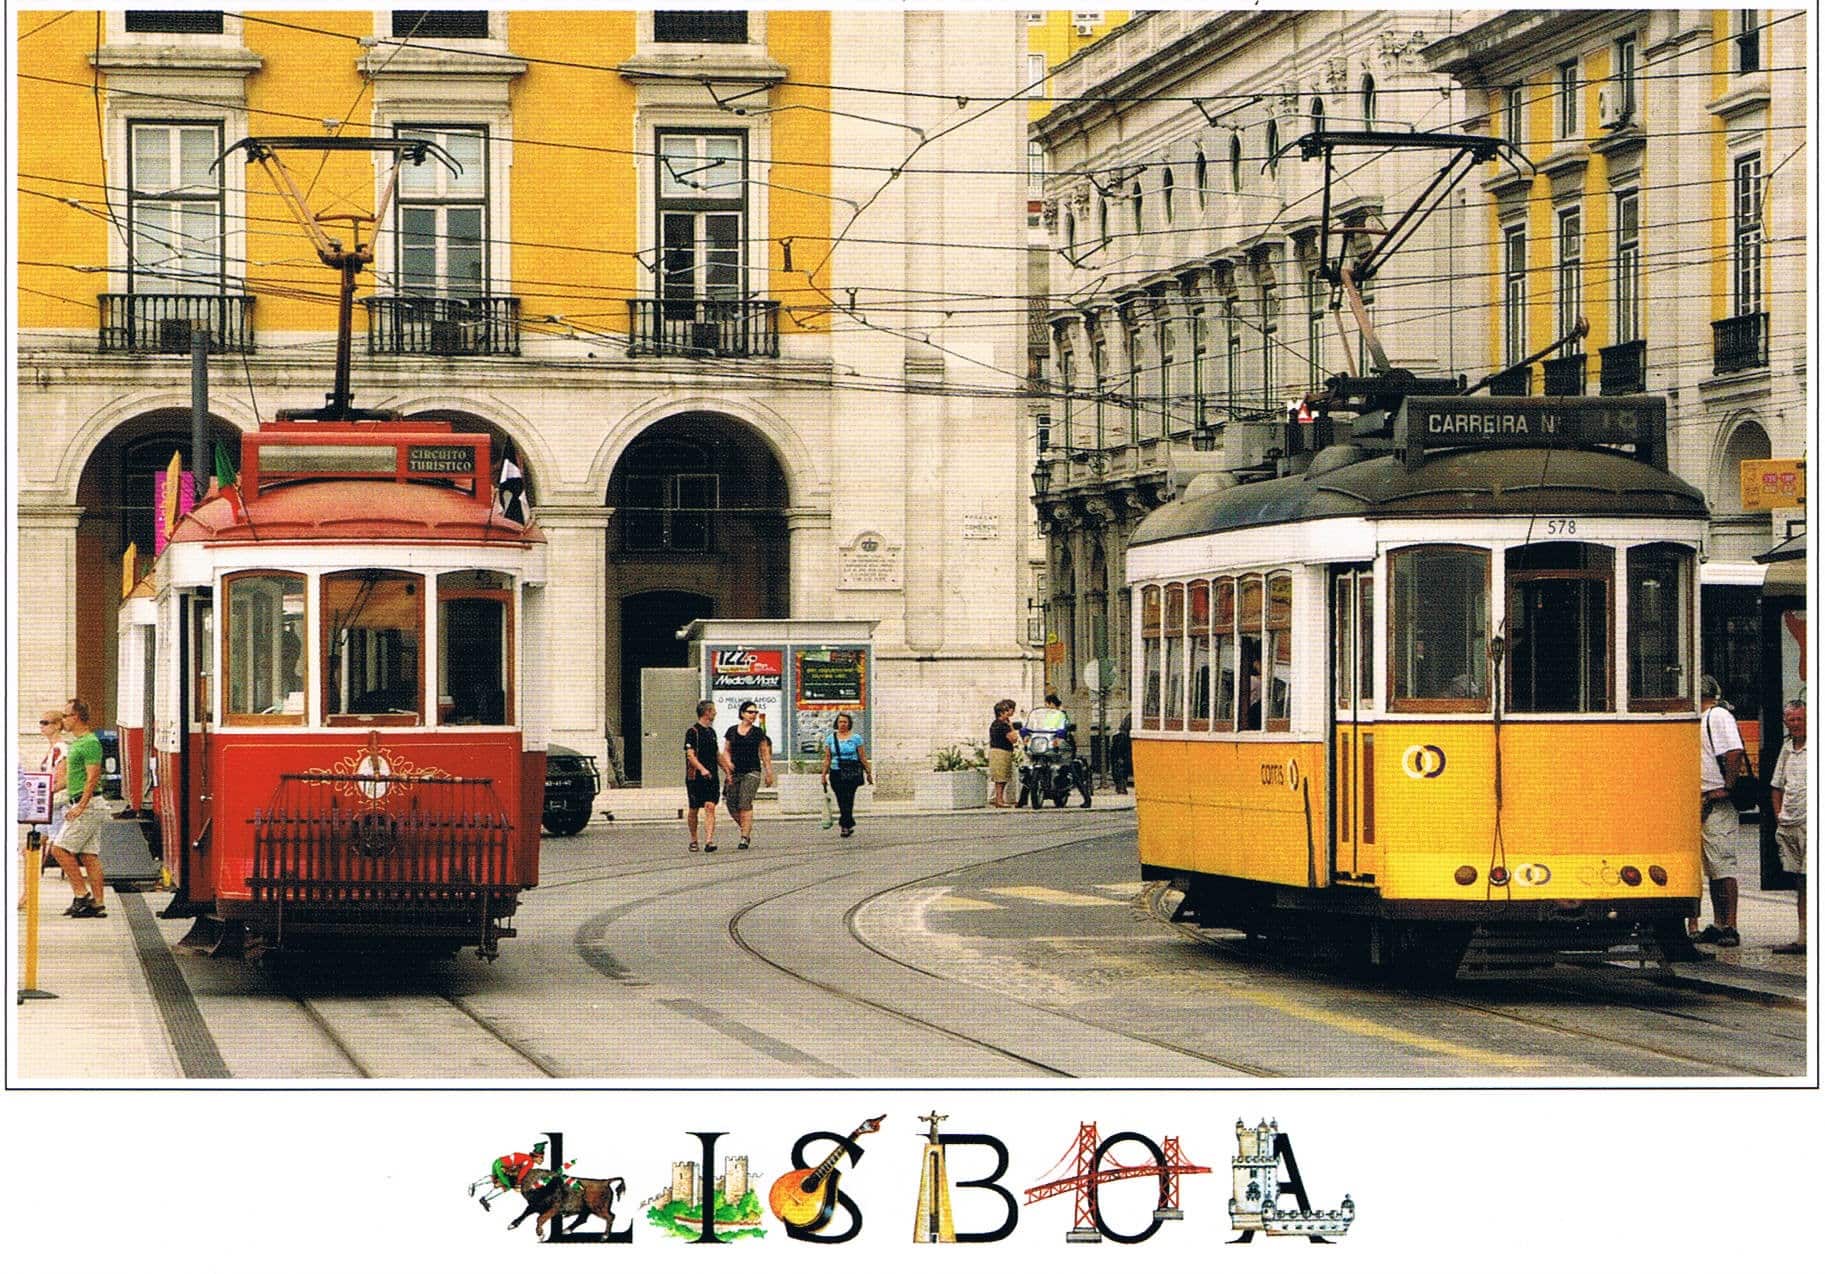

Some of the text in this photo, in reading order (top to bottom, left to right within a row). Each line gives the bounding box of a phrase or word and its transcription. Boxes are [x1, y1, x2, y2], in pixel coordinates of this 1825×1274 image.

[1428, 414, 1529, 434] CARREIRA
[411, 450, 467, 460] CIRCUITO
[1547, 520, 1577, 535] 578
